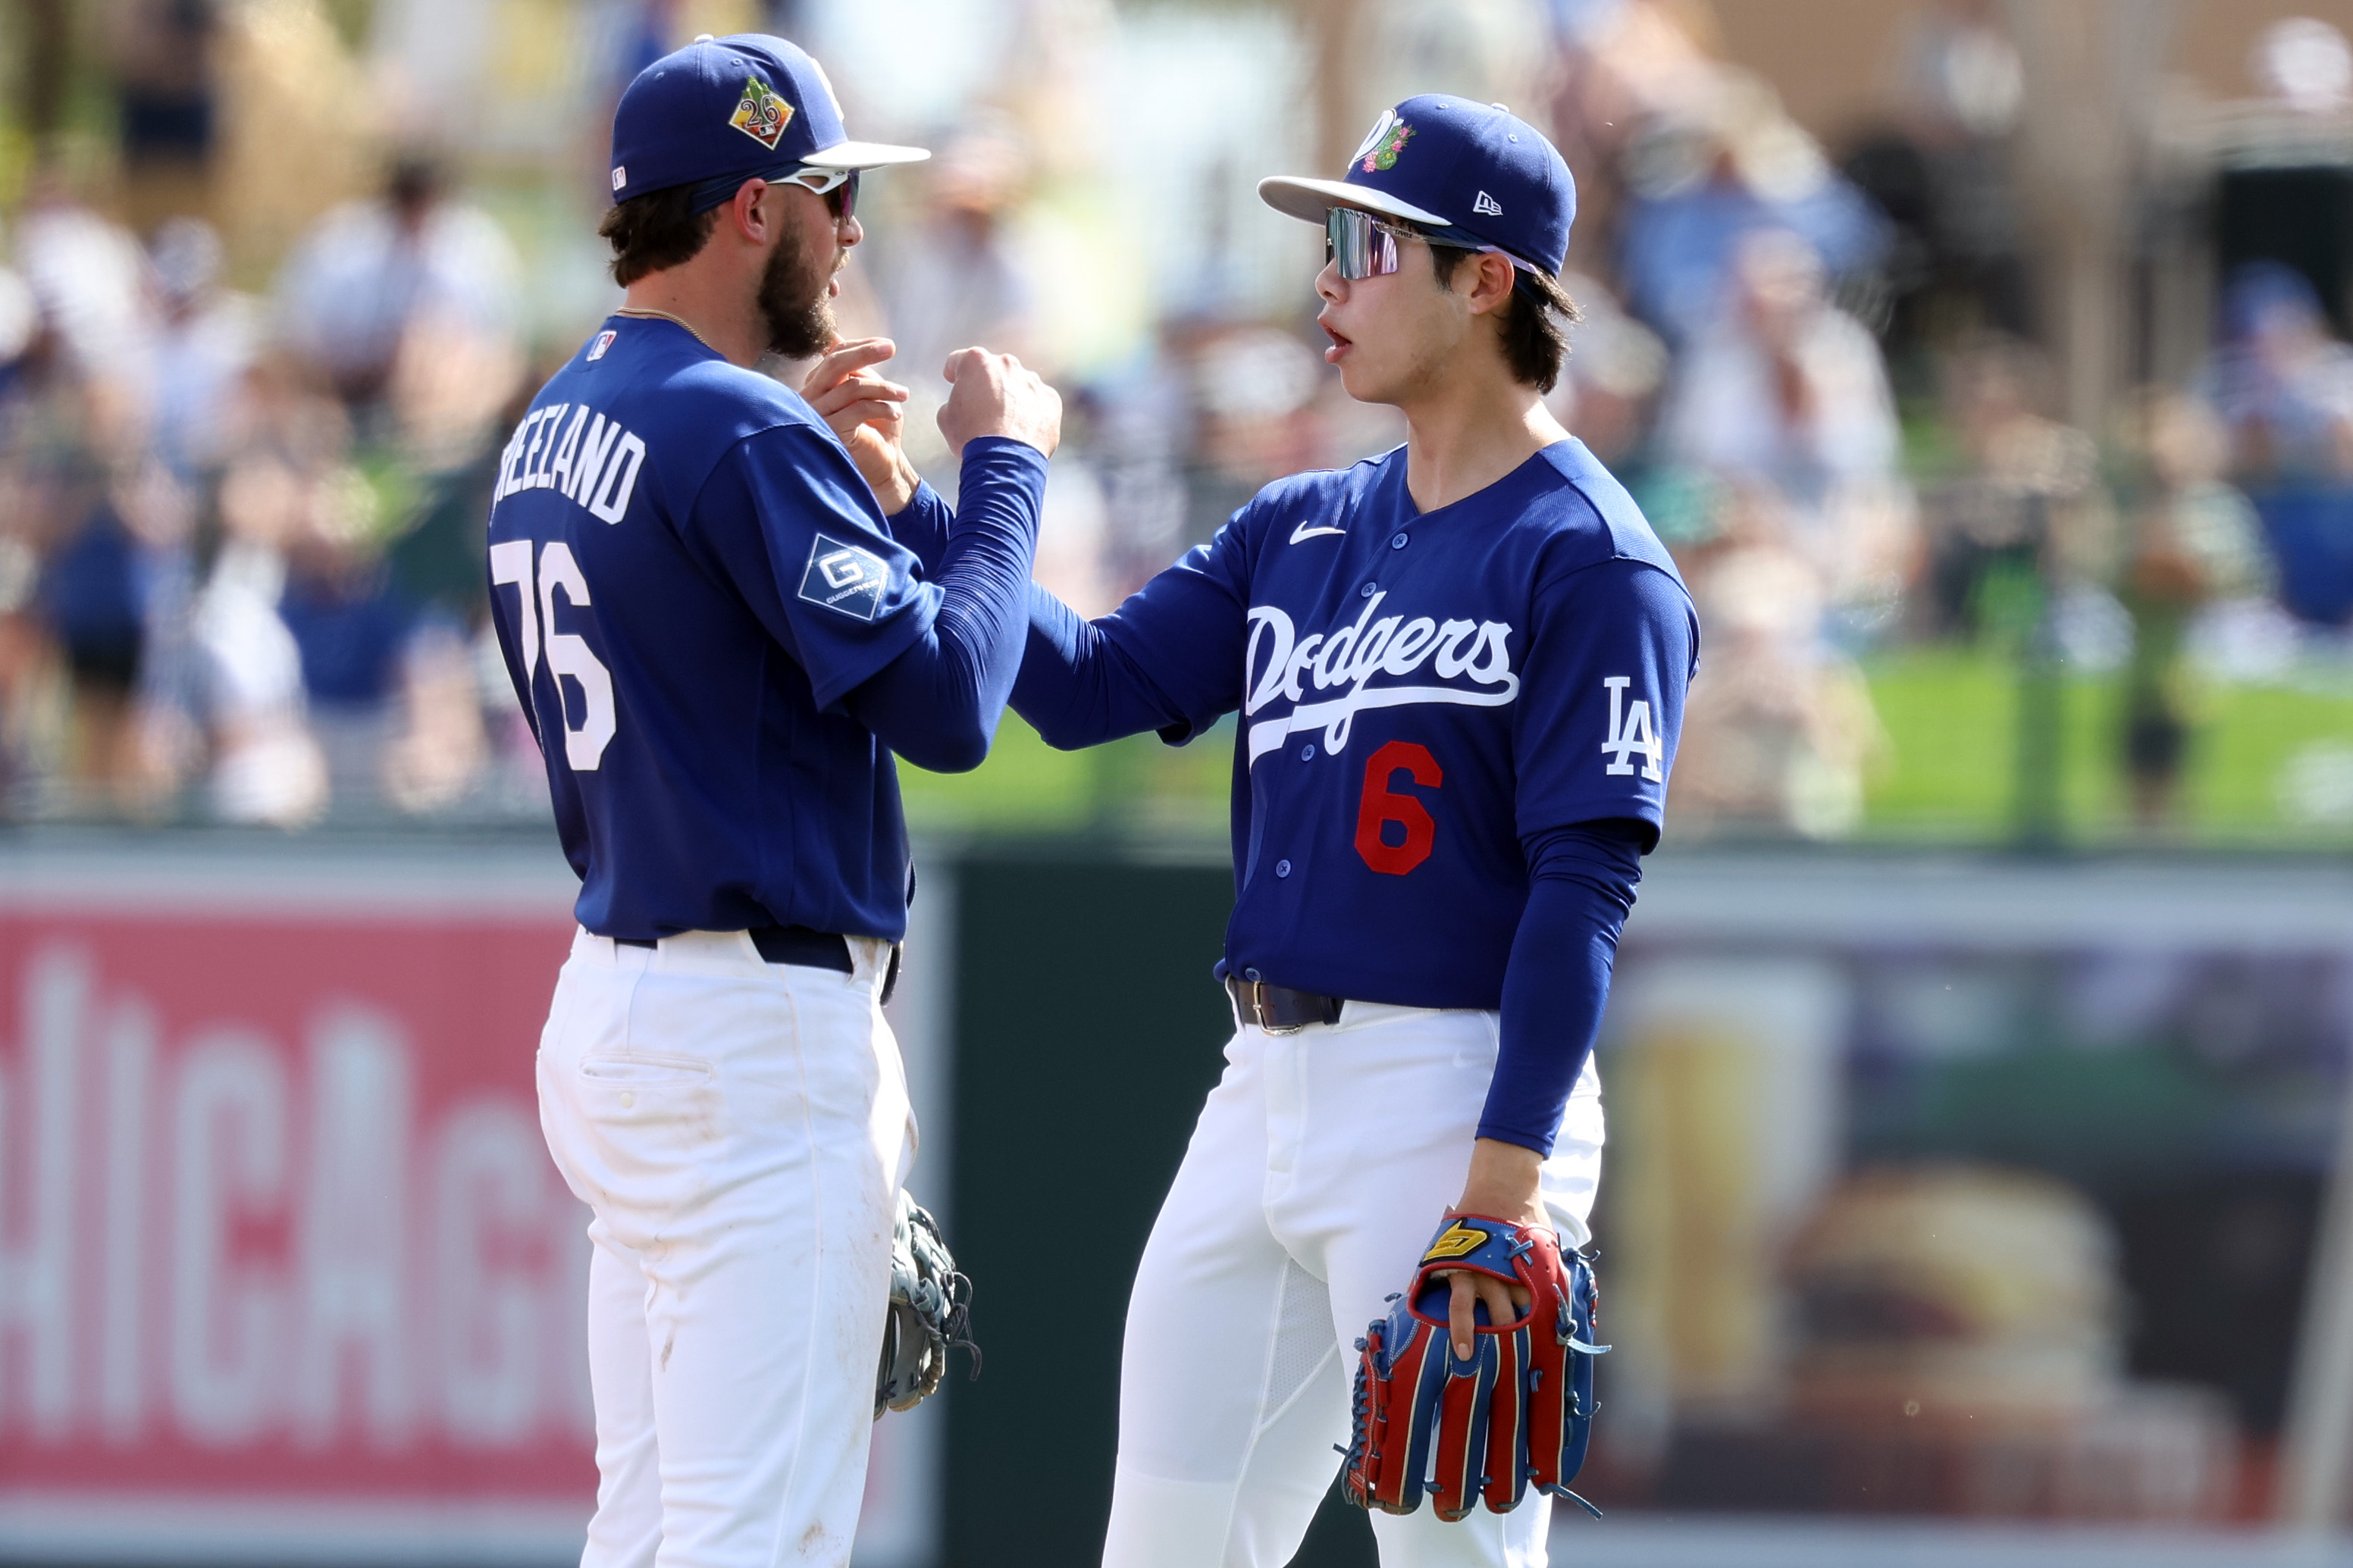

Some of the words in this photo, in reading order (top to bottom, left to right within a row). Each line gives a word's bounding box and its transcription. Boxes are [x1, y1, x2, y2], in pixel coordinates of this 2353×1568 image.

[741, 95, 781, 130] 26
[826, 579, 880, 604] GUGGEN
[490, 539, 616, 771] 76
[1245, 591, 1519, 756] Dodgers
[1601, 677, 1662, 783] LA
[1355, 740, 1443, 875] 6
